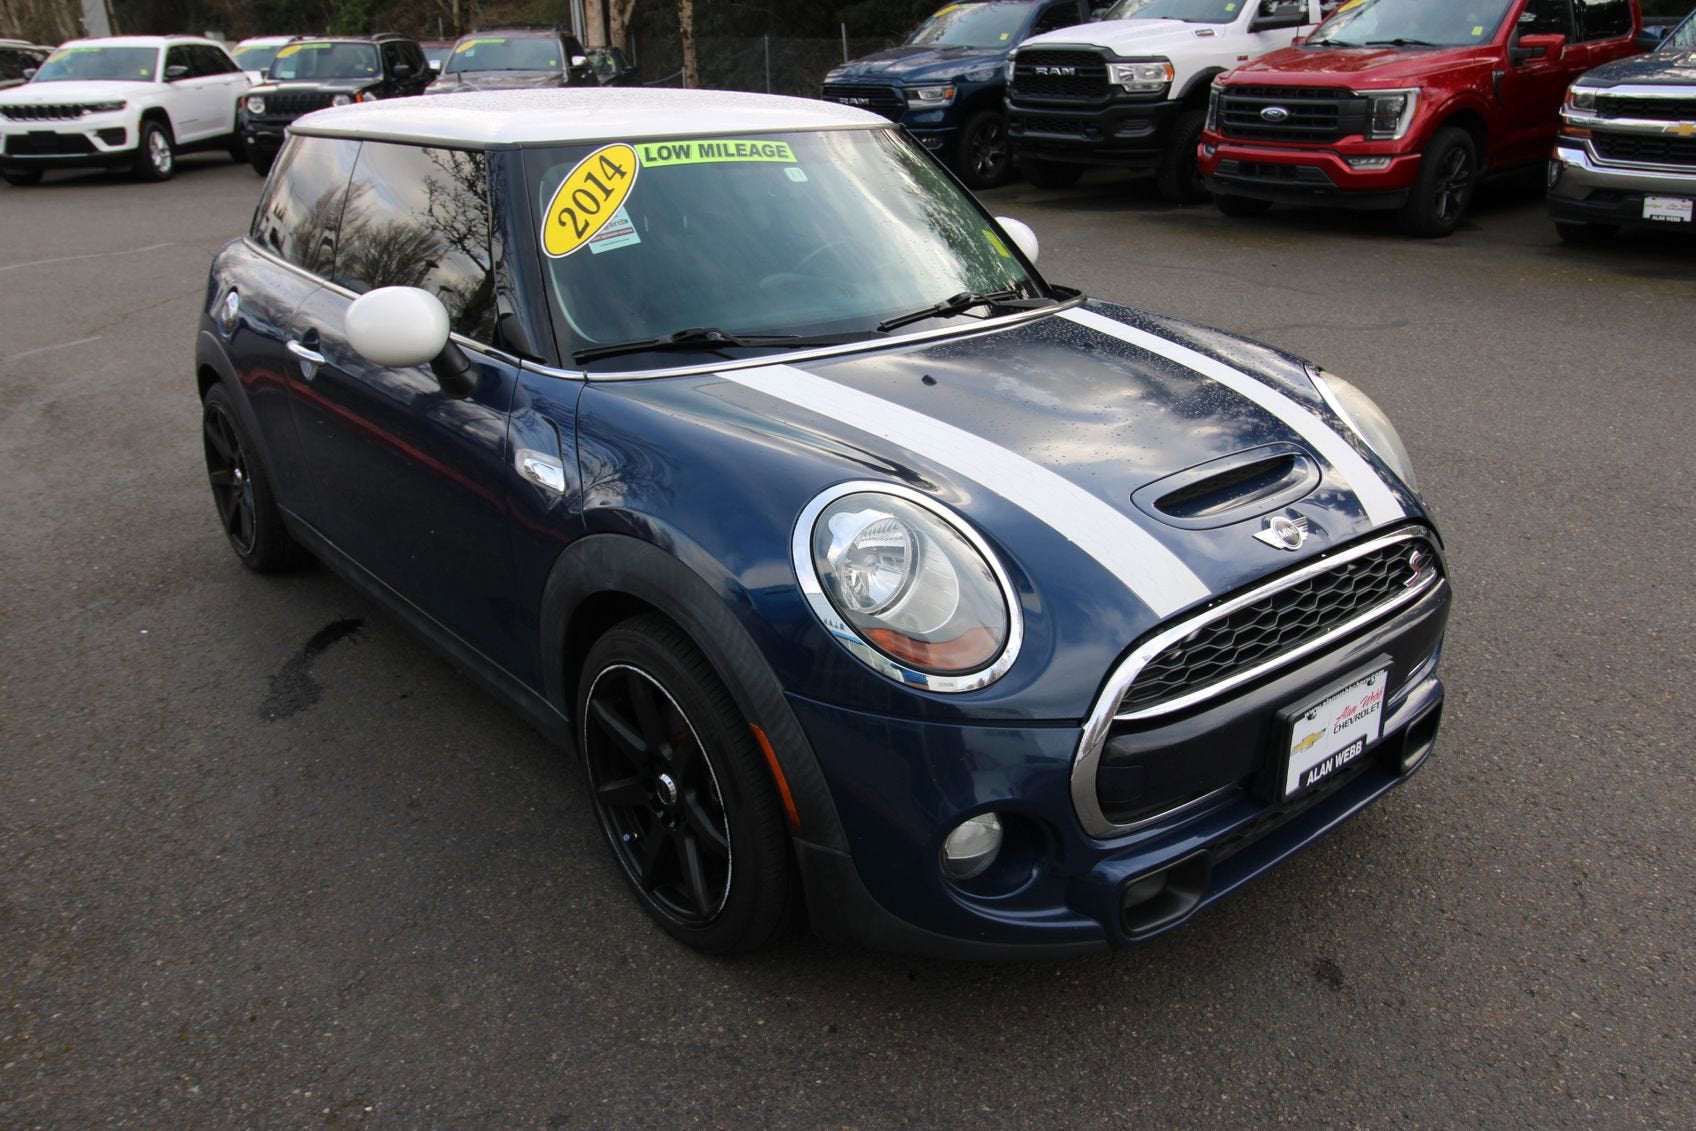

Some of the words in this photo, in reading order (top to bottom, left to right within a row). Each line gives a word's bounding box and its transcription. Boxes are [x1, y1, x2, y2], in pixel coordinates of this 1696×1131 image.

[1035, 67, 1076, 76] RAM
[839, 97, 870, 105] RAM
[644, 144, 691, 162] LOW
[699, 143, 789, 159] MILEAGE
[558, 155, 628, 239] 2014
[1277, 526, 1299, 540] MINI
[1333, 701, 1380, 735] CHEVROLET
[1306, 758, 1333, 786] ALAN
[1335, 740, 1362, 768] WEBB
